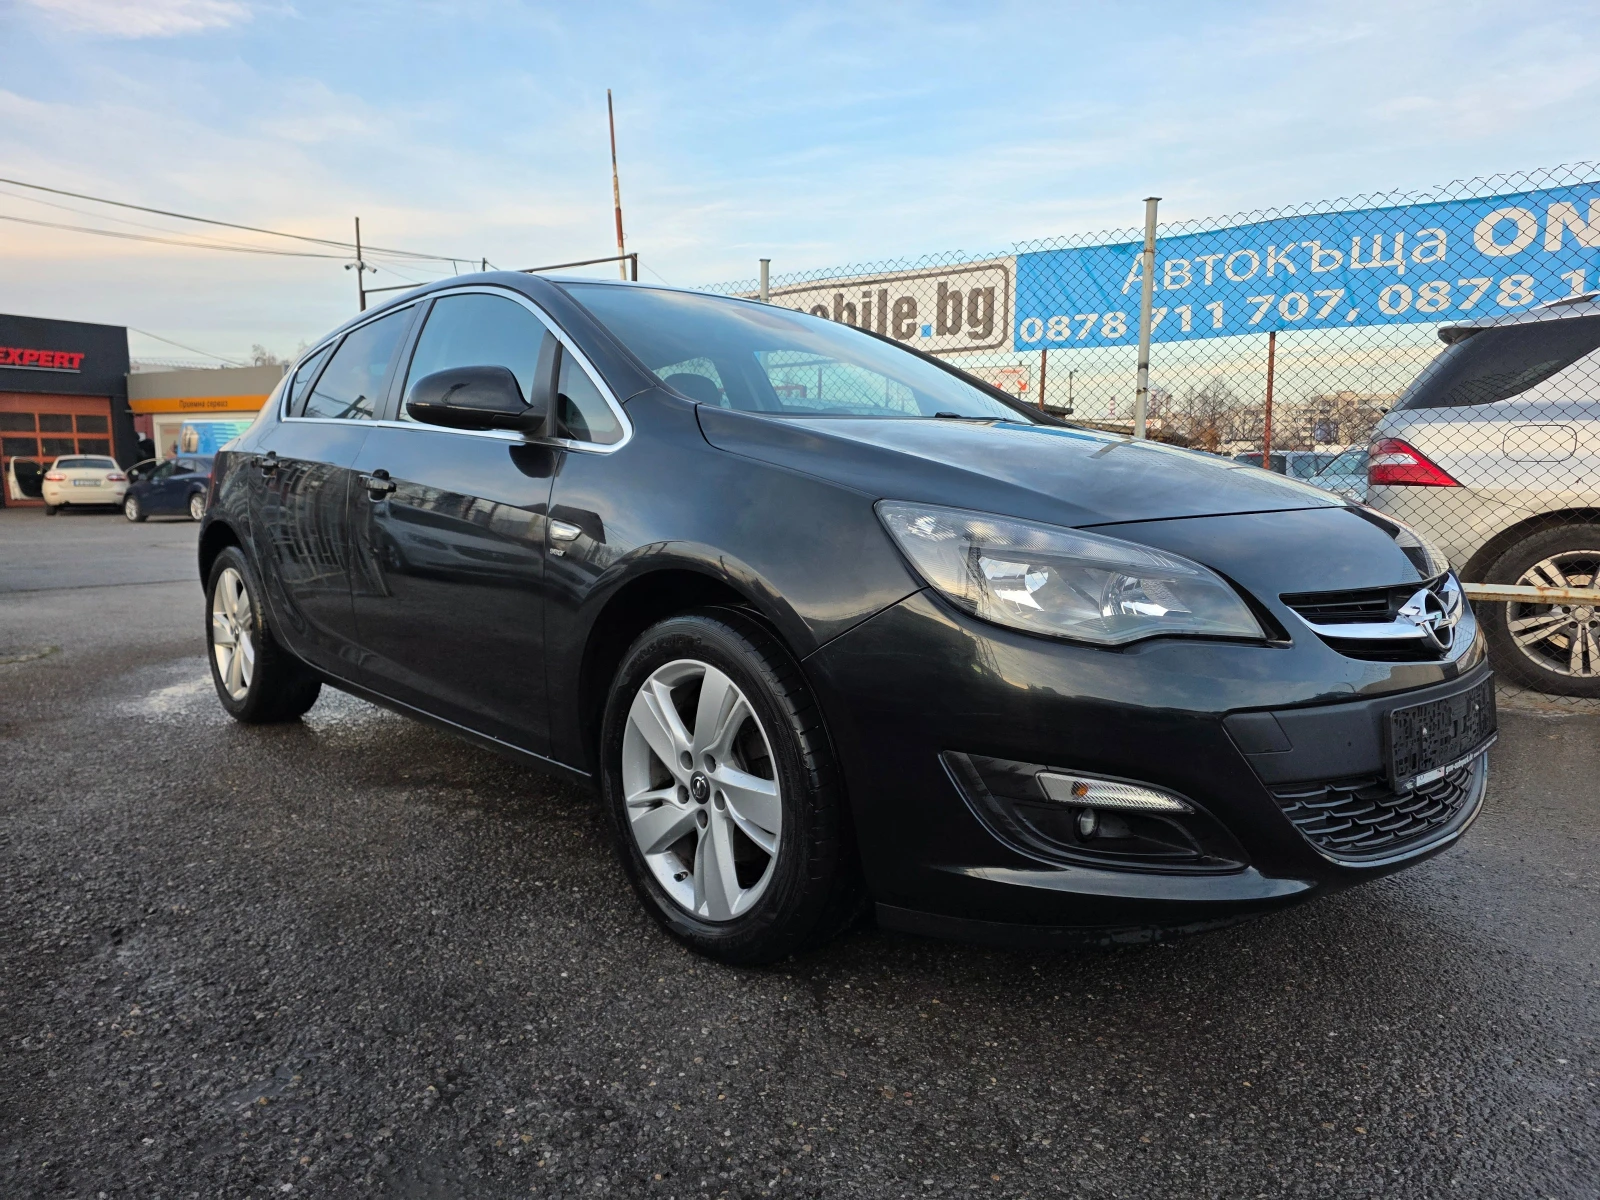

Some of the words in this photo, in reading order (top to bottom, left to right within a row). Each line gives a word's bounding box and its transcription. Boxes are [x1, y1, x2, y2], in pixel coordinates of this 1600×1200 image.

[1121, 228, 1447, 295] Автокъща
[1474, 198, 1600, 257] ON
[795, 281, 995, 341] bile.bg
[1019, 311, 1127, 343] 0878
[1150, 300, 1223, 335] 711
[1246, 288, 1360, 325] 707,
[1378, 274, 1535, 315] 0878
